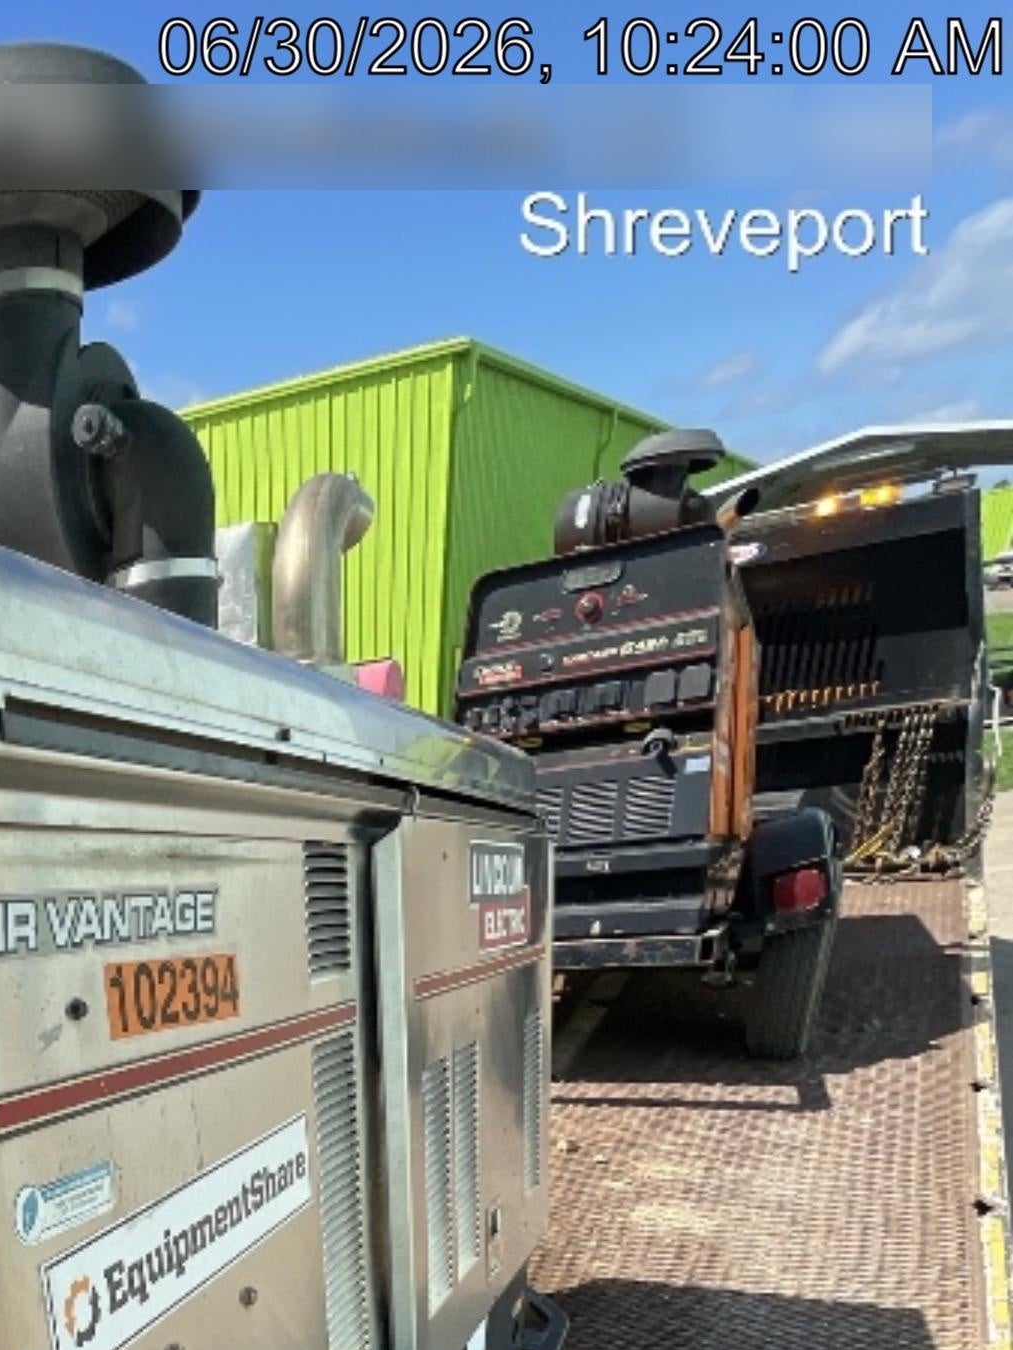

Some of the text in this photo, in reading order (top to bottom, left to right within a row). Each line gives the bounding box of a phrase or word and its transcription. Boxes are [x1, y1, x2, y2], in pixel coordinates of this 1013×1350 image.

[45, 892, 216, 947] VANTAGE
[109, 956, 240, 1033] 102394
[103, 1151, 307, 1315] EquipmentShare
